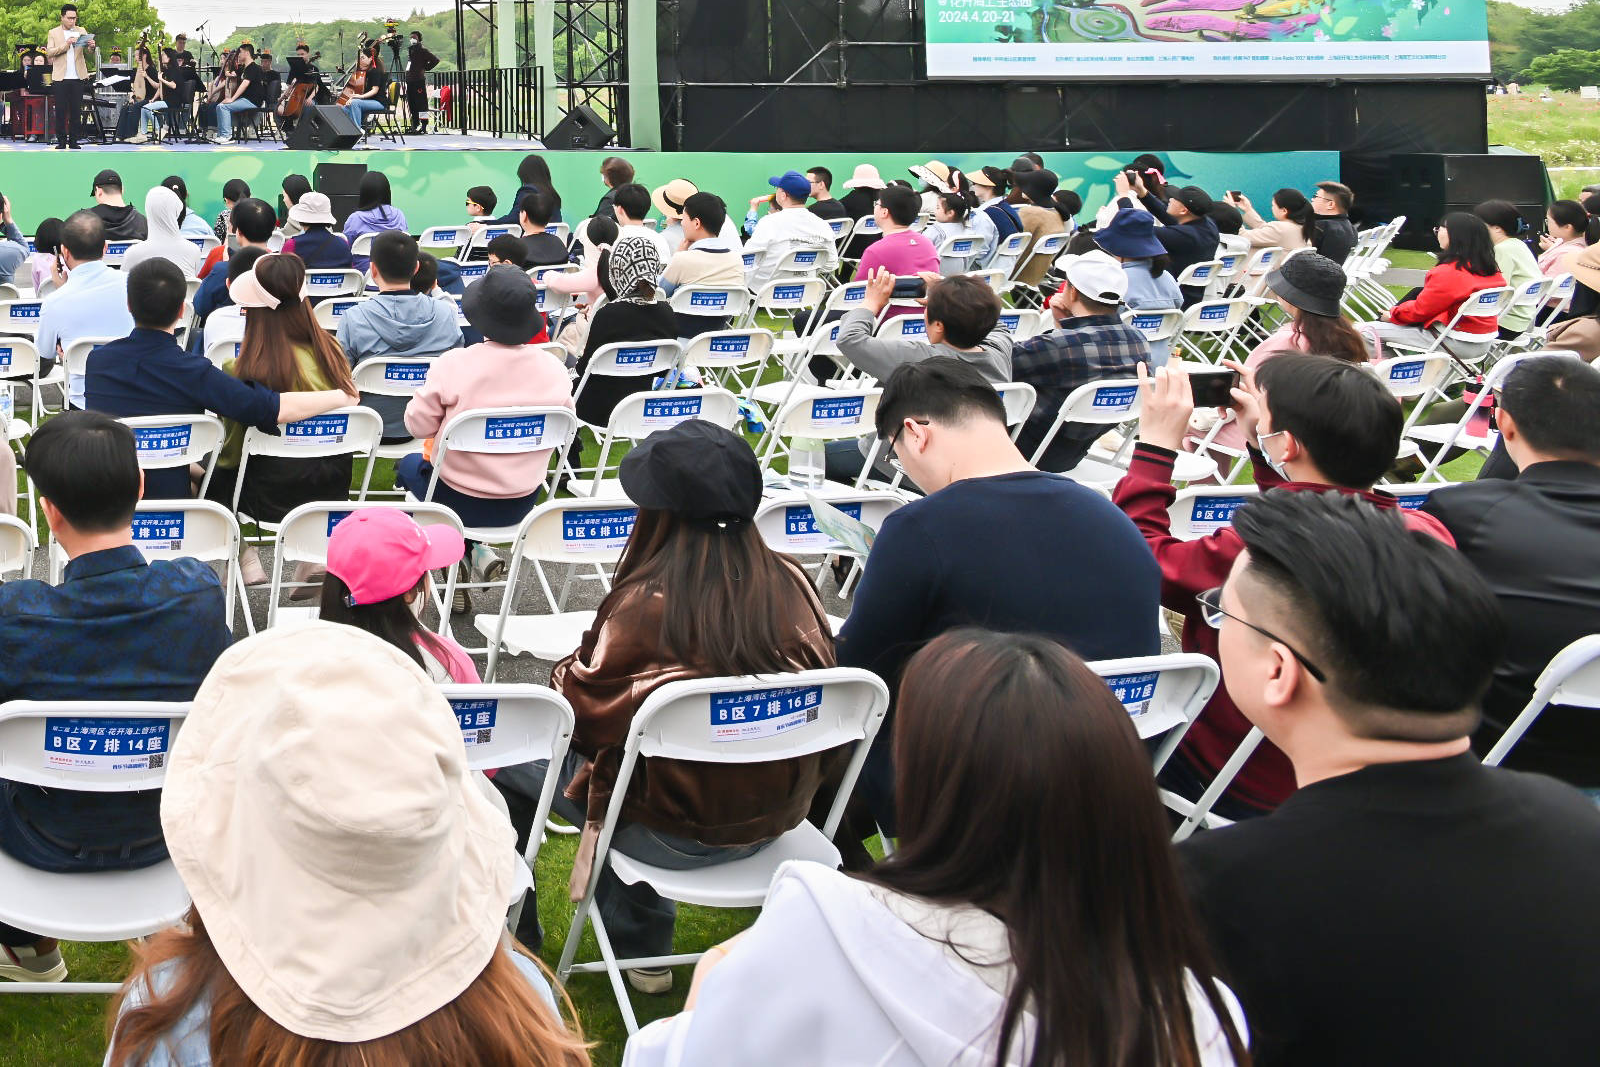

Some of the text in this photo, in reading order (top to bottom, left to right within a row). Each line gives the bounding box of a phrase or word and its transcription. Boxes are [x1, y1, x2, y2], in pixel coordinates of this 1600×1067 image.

[939, 10, 1015, 22] 2024.4.20-21
[719, 691, 818, 720] B区7排16座
[53, 736, 162, 753] B区7排14座
